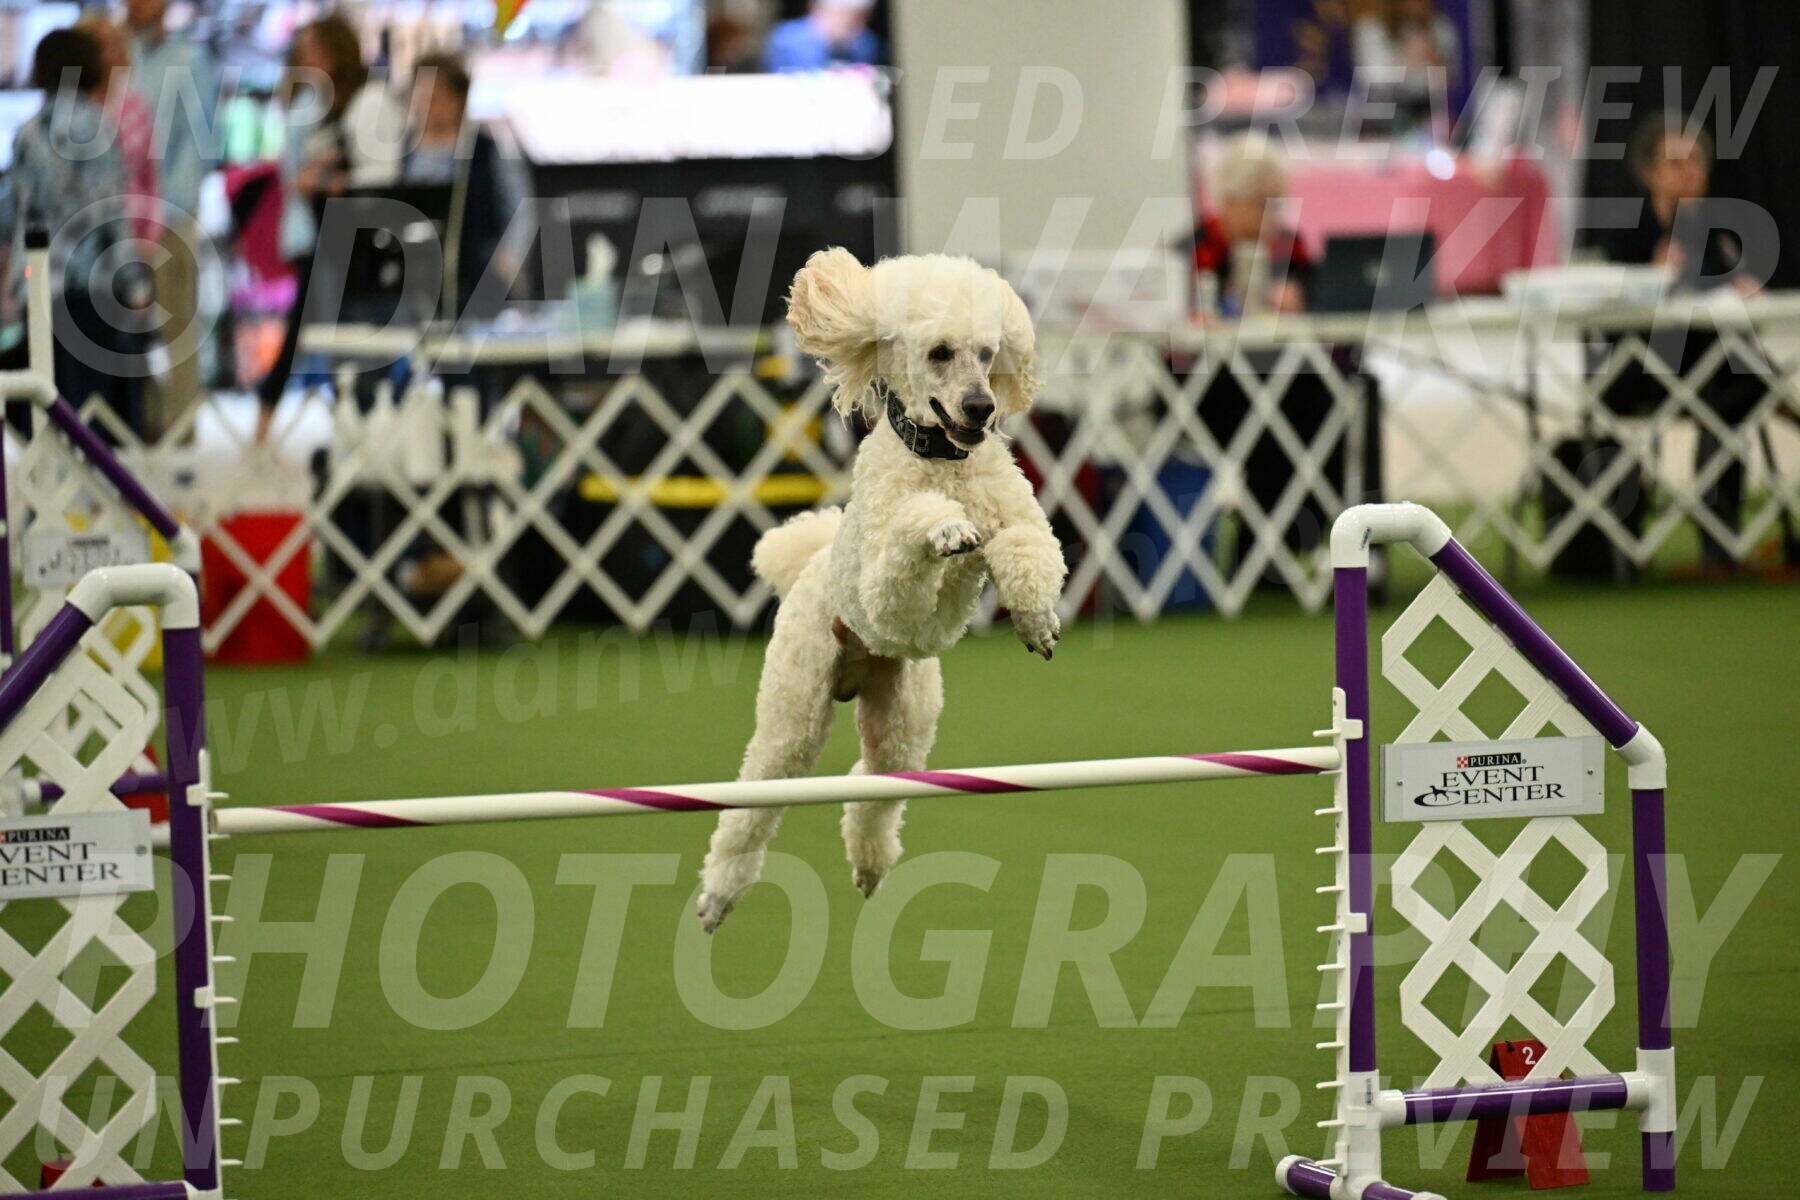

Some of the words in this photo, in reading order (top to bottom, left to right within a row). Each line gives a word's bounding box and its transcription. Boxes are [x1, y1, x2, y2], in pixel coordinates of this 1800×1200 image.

[1470, 754, 1520, 767] PURINA
[1440, 766, 1545, 788] EVENT
[1413, 783, 1567, 808] CENTER
[8, 829, 68, 842] PURINA
[0, 842, 96, 864] VENT
[0, 862, 121, 886] ENTER
[1522, 1046, 1537, 1065] 2
